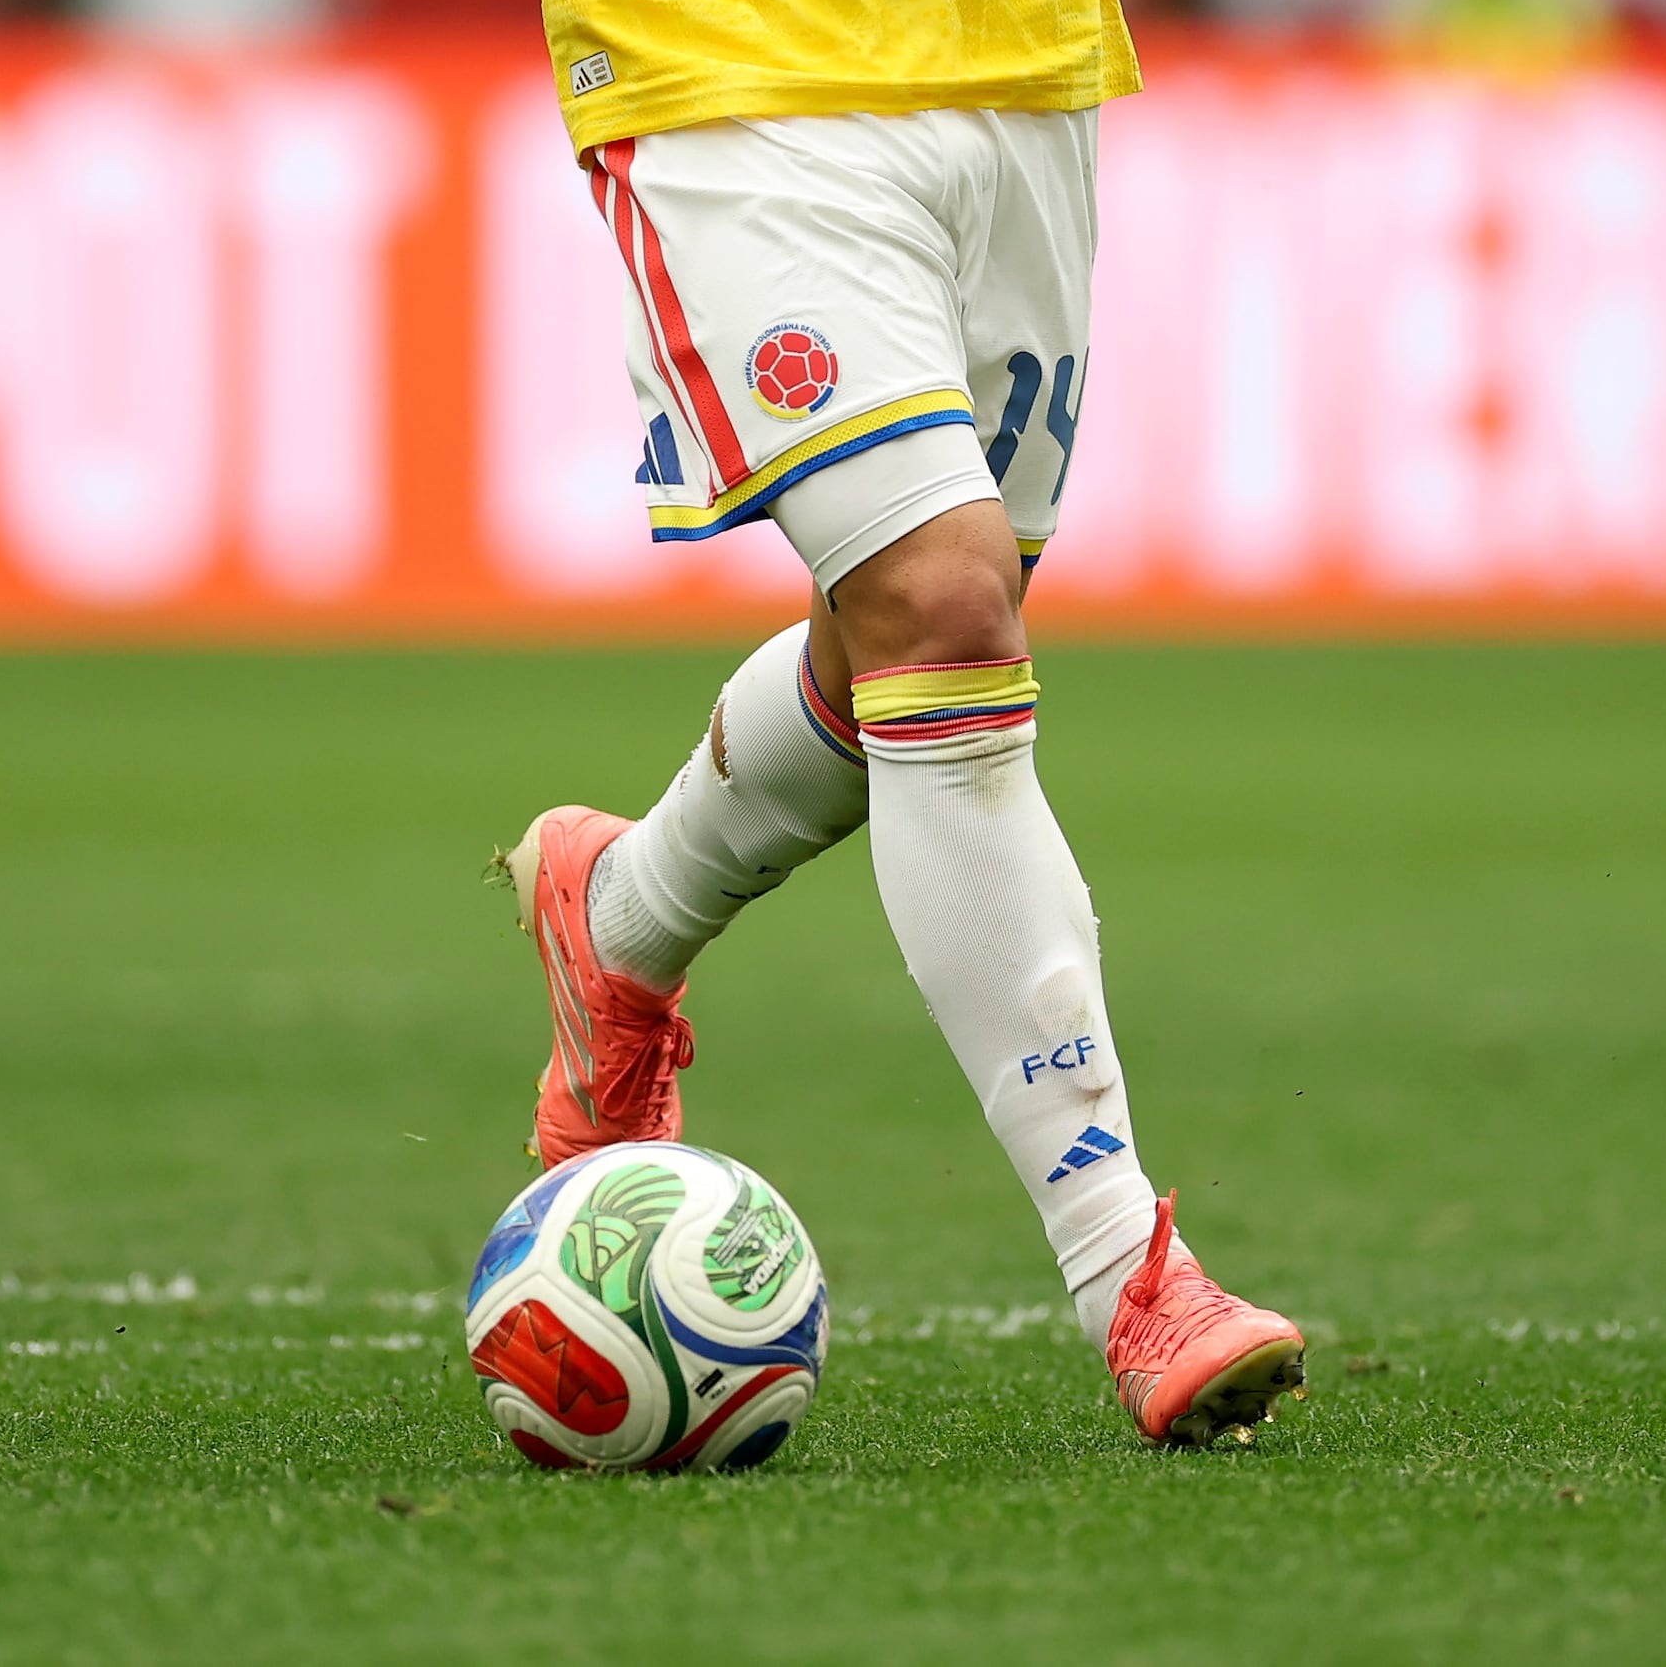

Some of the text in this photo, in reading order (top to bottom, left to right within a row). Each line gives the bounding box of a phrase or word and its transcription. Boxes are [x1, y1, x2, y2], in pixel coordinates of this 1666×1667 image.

[755, 323, 800, 345] COLOMBIANA
[800, 324, 810, 334] DE
[1020, 1035, 1097, 1085] FCF
[743, 1230, 796, 1295] TRIONDA
